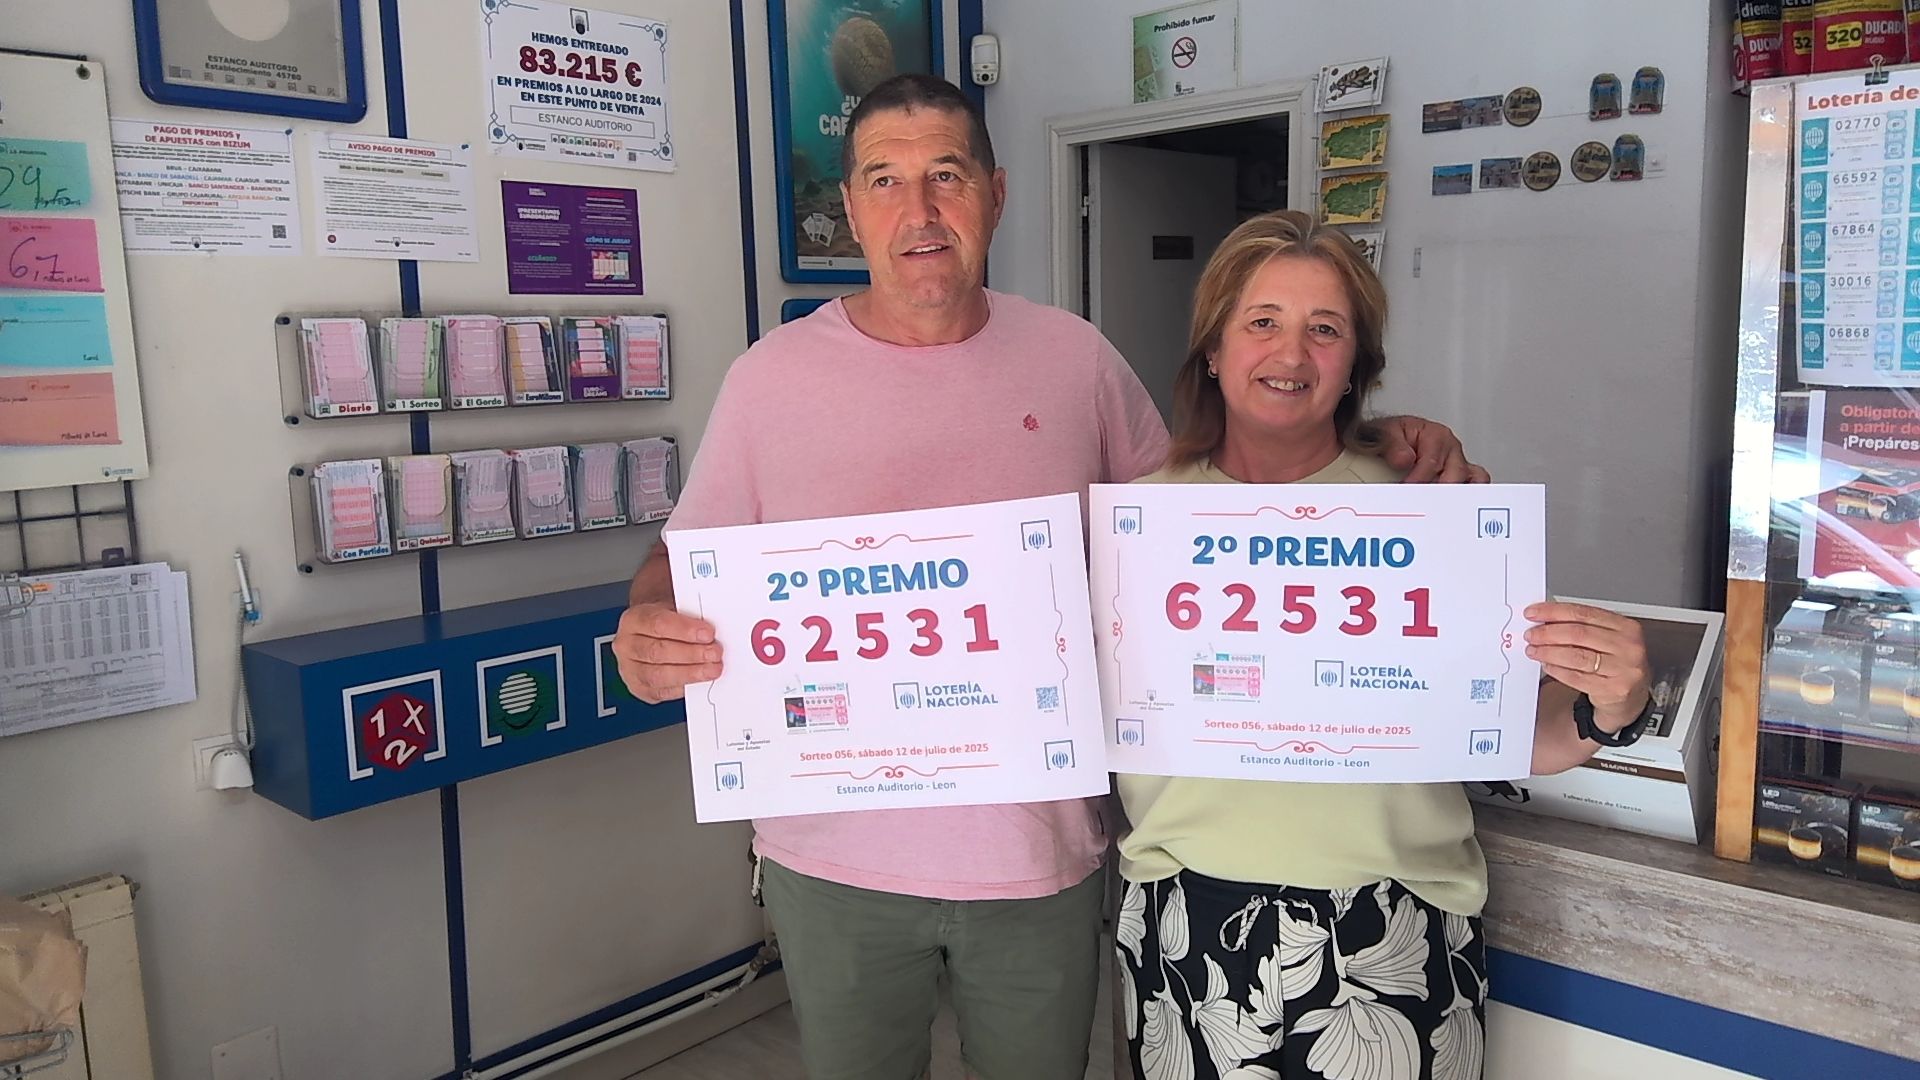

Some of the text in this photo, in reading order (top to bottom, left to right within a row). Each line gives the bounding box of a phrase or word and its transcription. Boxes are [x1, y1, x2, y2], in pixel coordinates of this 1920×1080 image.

[1154, 14, 1216, 33] Prohibido fumar
[1826, 27, 1861, 45] 320
[531, 32, 629, 56] HEMOS ENTREGADO
[208, 55, 297, 72] ESTANCO AUDITORIO
[519, 45, 642, 87] 83.215 €
[497, 76, 662, 106] EN PREMIOS A LO LARGO DE 2024
[1808, 85, 1919, 110] Lotería de
[520, 92, 645, 116] EN ESTE PUNTO DE VENTA
[538, 113, 633, 132] ESTANCO AUDITORIO
[1835, 117, 1881, 131] 02770
[153, 126, 180, 134] PAGO
[195, 128, 233, 139] PREMIOS
[145, 134, 155, 143] DE
[159, 136, 204, 146] APUESTAS
[223, 140, 251, 149] BIZUM
[348, 142, 371, 151] AVISO
[373, 145, 392, 153] PAGO
[405, 148, 436, 157] PREMIOS
[1833, 171, 1877, 184] 66592
[1832, 223, 1874, 236] 67864
[1830, 276, 1871, 287] 30016
[1829, 327, 1870, 338] 06868
[339, 403, 372, 413] Diario
[410, 400, 440, 409] Sorteo
[475, 397, 502, 406] Gordo
[1840, 423, 1849, 432] a
[1854, 421, 1896, 434] partir
[343, 546, 388, 558] Con Partidos
[1249, 537, 1415, 568] PREMIO
[818, 558, 970, 598] PREMIO
[1165, 582, 1438, 638] 62531
[750, 603, 999, 666] 62531
[1774, 634, 1791, 643] LED
[1876, 645, 1894, 654] LED
[1350, 665, 1413, 678] LOTERÍA
[925, 681, 982, 696] LOTERÍA
[1350, 678, 1429, 691] NACIONAL
[927, 694, 998, 708] NACIONAL
[370, 699, 426, 738] 1 X
[1204, 719, 1412, 735] Sorteo 056, sábado 12 de julio de 2025
[384, 739, 418, 765] 2
[800, 743, 989, 761] Sorteo 056, sábado 12 de julio de 2025
[1240, 755, 1281, 766] Estanco
[1284, 756, 1335, 767] Auditorio
[1344, 759, 1370, 768] Leon
[836, 783, 875, 795] Estanco
[877, 780, 923, 793] Auditorio
[932, 780, 957, 791] Leon
[1762, 788, 1780, 797] LED
[1862, 805, 1881, 814] LED
